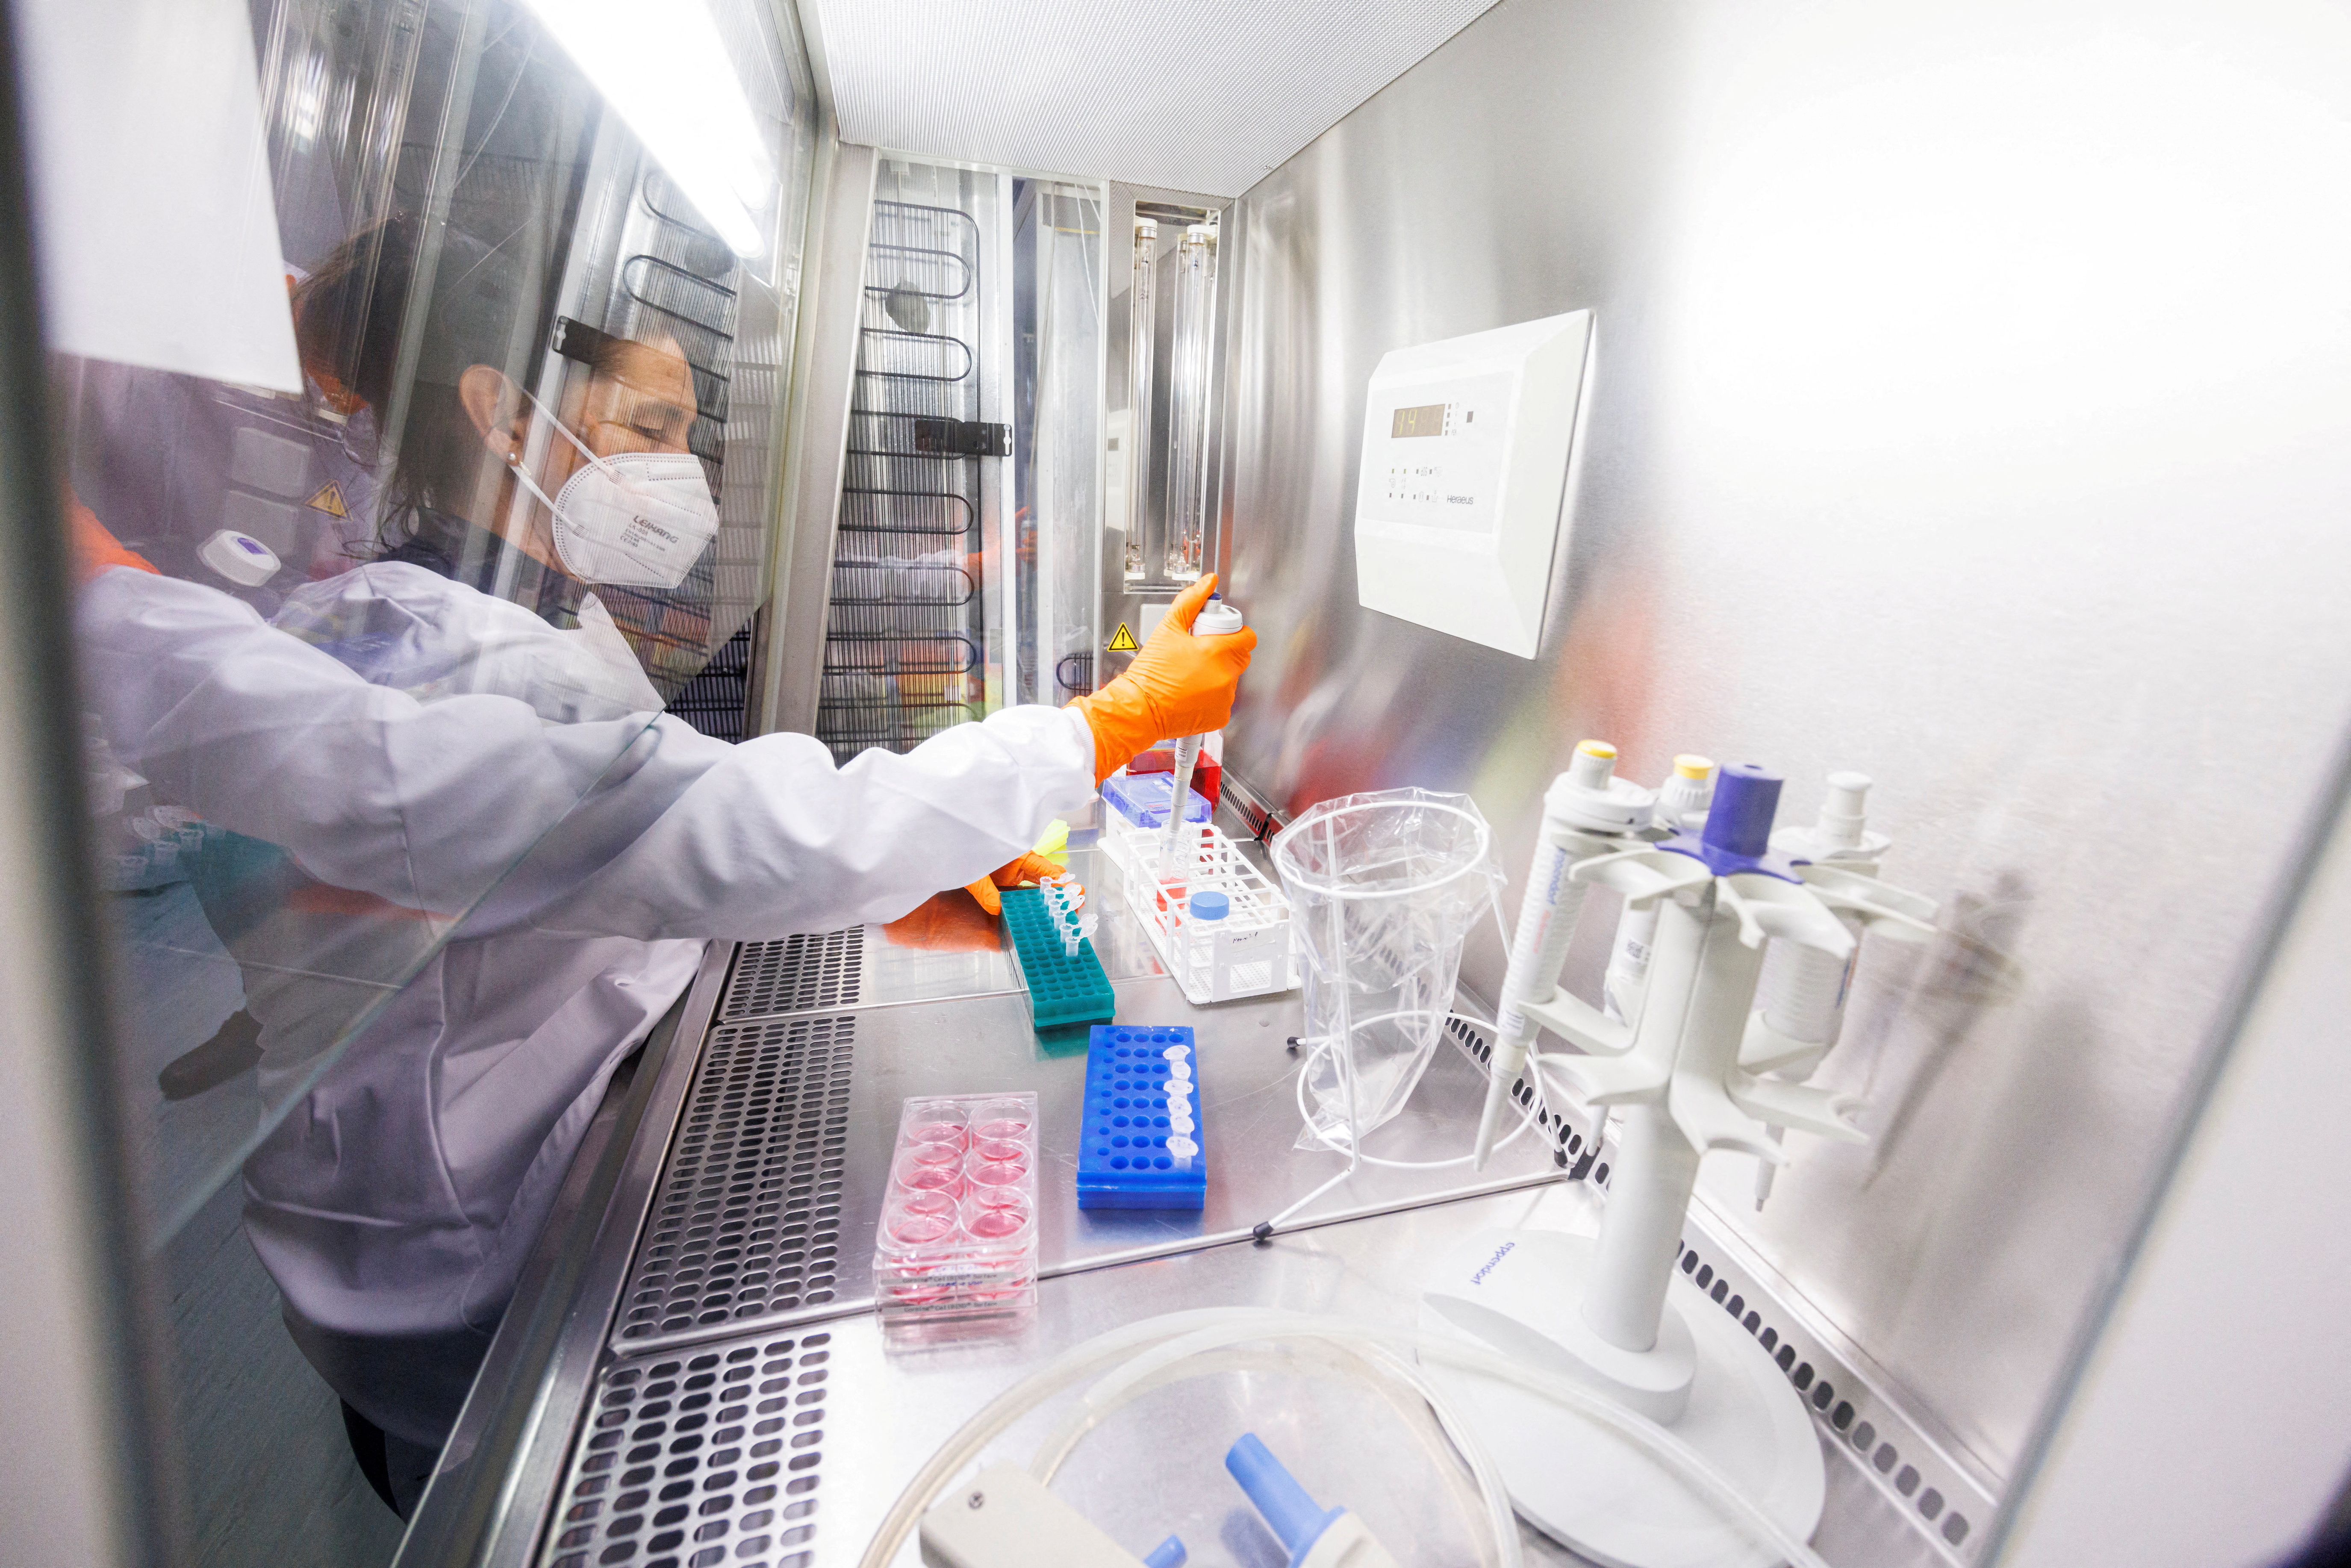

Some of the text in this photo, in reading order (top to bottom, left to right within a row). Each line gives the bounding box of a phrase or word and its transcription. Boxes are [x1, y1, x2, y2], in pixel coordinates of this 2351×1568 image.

[1399, 410, 1417, 435] 14
[1447, 495, 1473, 505] Heraeus
[633, 516, 679, 544] LEIHANG
[1470, 1242, 1515, 1285] eppendorf
